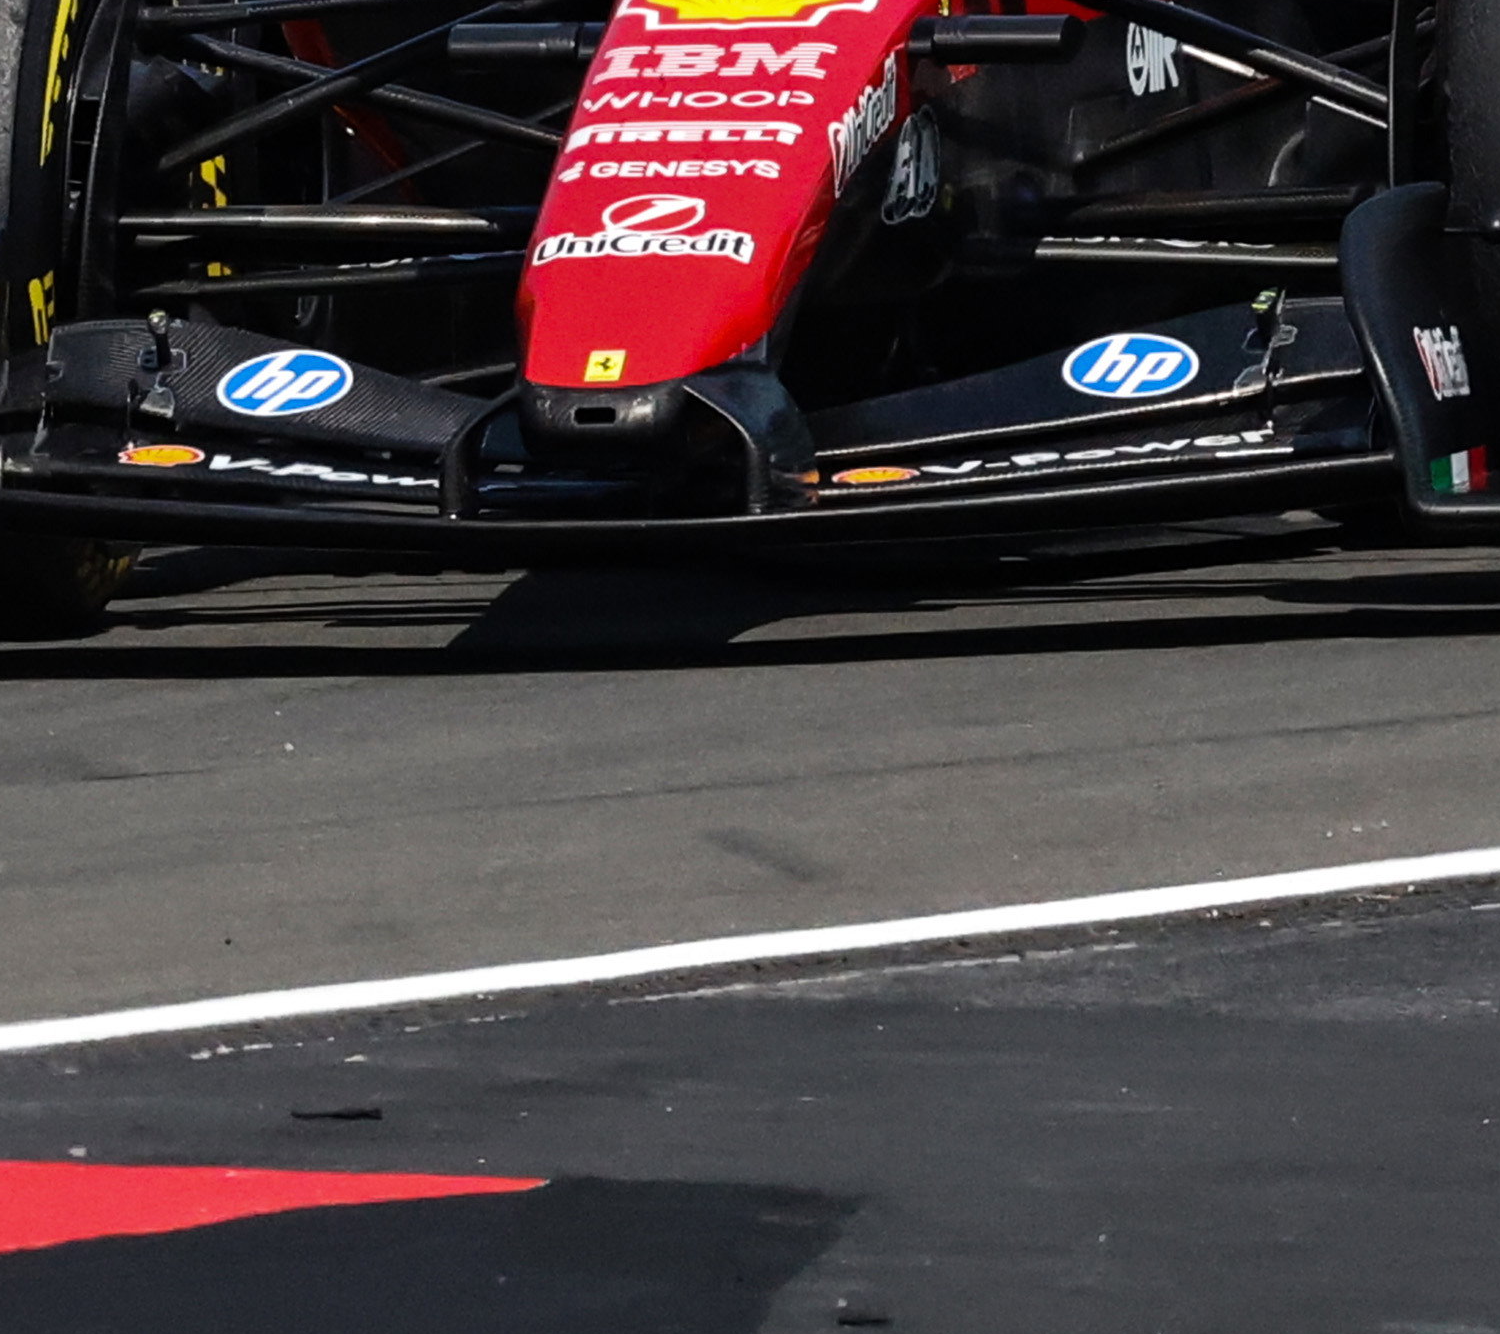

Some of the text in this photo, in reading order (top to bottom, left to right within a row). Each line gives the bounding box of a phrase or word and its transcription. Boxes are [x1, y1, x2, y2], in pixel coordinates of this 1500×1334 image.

[592, 42, 838, 85] IBM
[582, 90, 815, 112] WHOOP
[564, 121, 803, 153] PIRELLI
[590, 159, 781, 180] GENESYS
[533, 229, 755, 264] UniCredit
[222, 350, 349, 416] hp
[1066, 334, 1196, 398] hp
[920, 428, 1274, 475] V-Power
